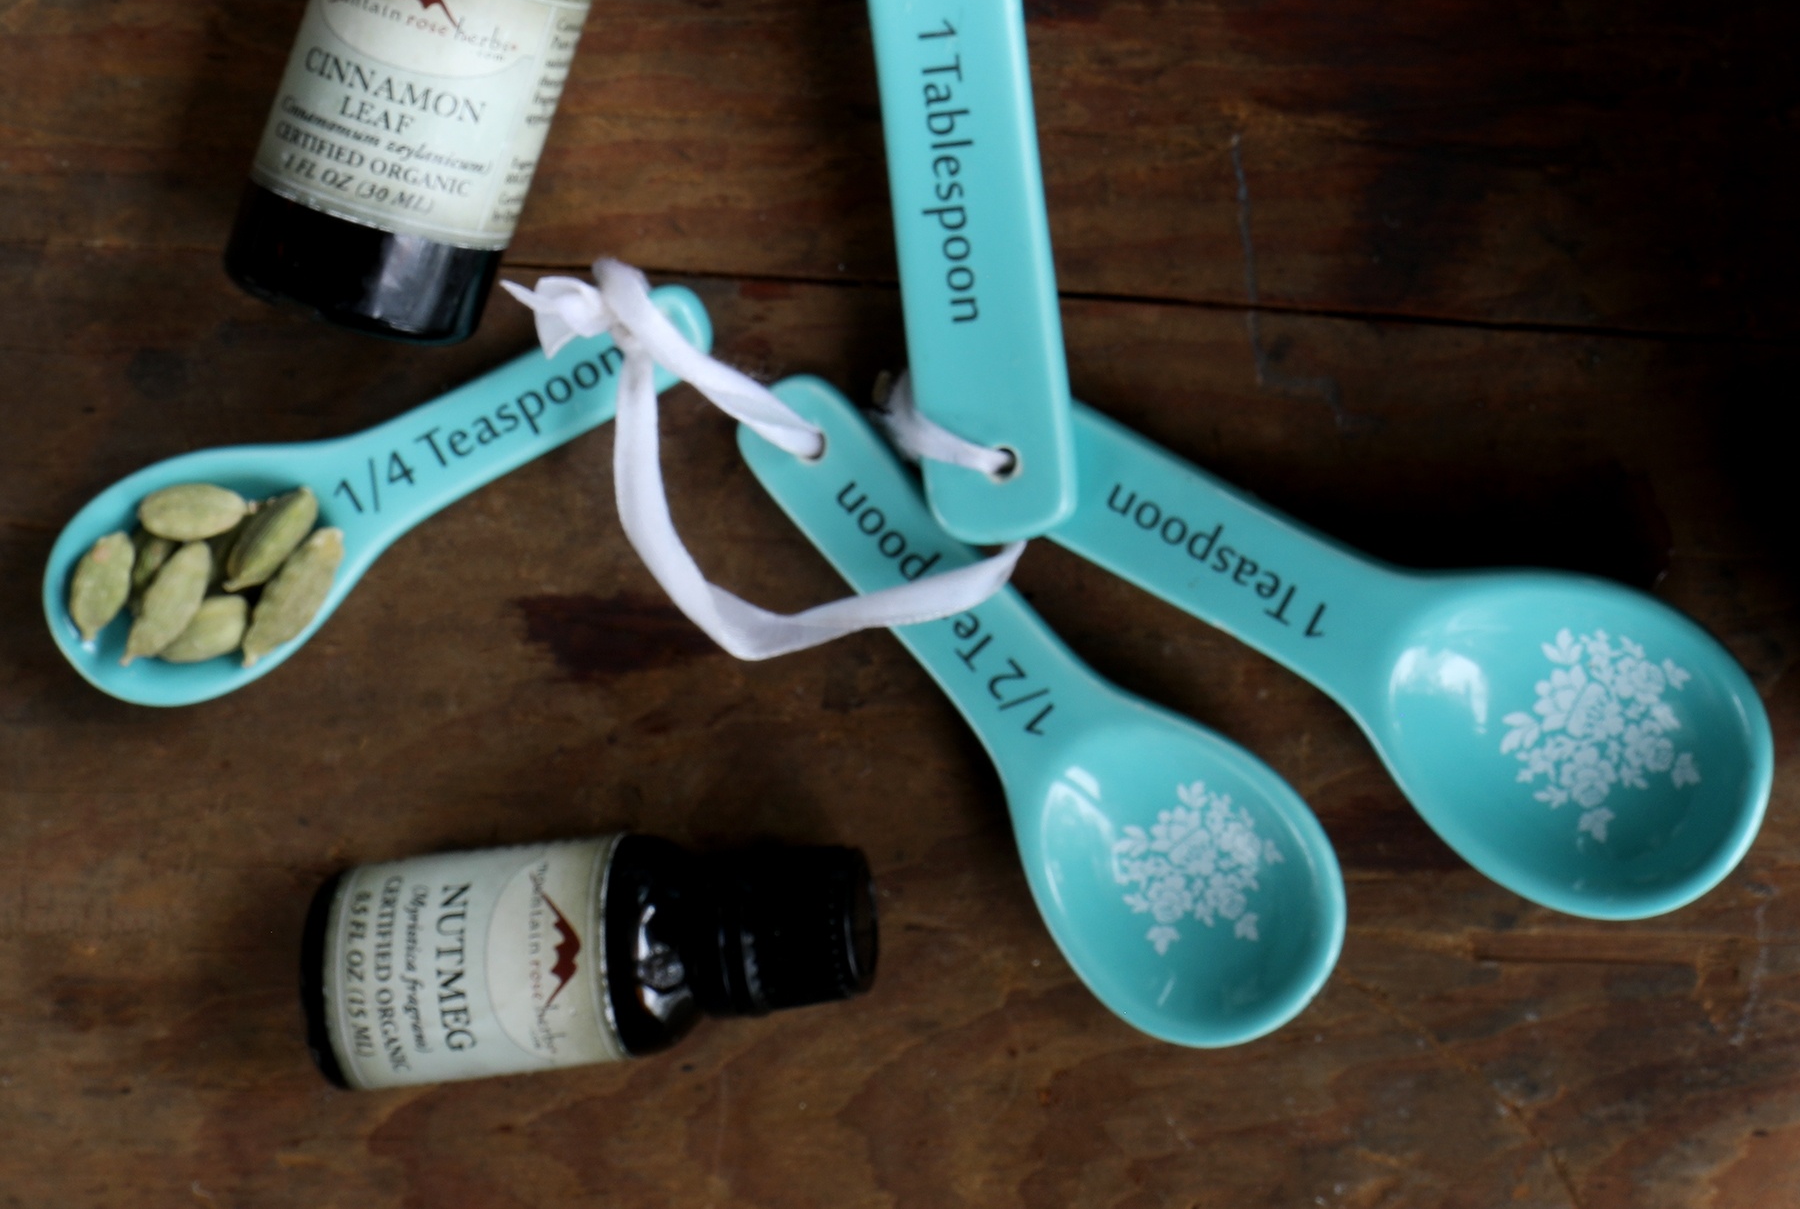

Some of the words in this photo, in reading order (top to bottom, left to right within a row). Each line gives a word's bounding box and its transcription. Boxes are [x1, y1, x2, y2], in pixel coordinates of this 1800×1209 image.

[405, 14, 448, 37] rose
[917, 18, 956, 39] 1
[305, 44, 486, 125] CINNAMON
[338, 94, 413, 135] LEAF
[274, 120, 366, 169] CERTIFIED
[372, 155, 471, 199] ORGANIC
[282, 153, 295, 170] 1
[292, 156, 316, 180] FL
[320, 166, 354, 193] OZ
[354, 178, 390, 203] (30
[389, 188, 435, 215] ML)
[921, 54, 980, 324] Tablespoon
[334, 449, 419, 513] 1/4
[414, 347, 624, 467] Teaspoon
[834, 479, 994, 673] Tepoon
[1102, 482, 1296, 625] Teaspoon
[1302, 600, 1327, 638] 1
[985, 657, 1057, 738] 1/2
[347, 917, 366, 942] FL
[373, 876, 401, 981] CERTIFIED
[345, 948, 364, 981] OZ
[435, 882, 476, 1051] NUTMEG
[529, 958, 541, 999] rose
[346, 988, 368, 1015] (15
[374, 987, 412, 1072] ORGANIC
[352, 1021, 372, 1057] ML)
